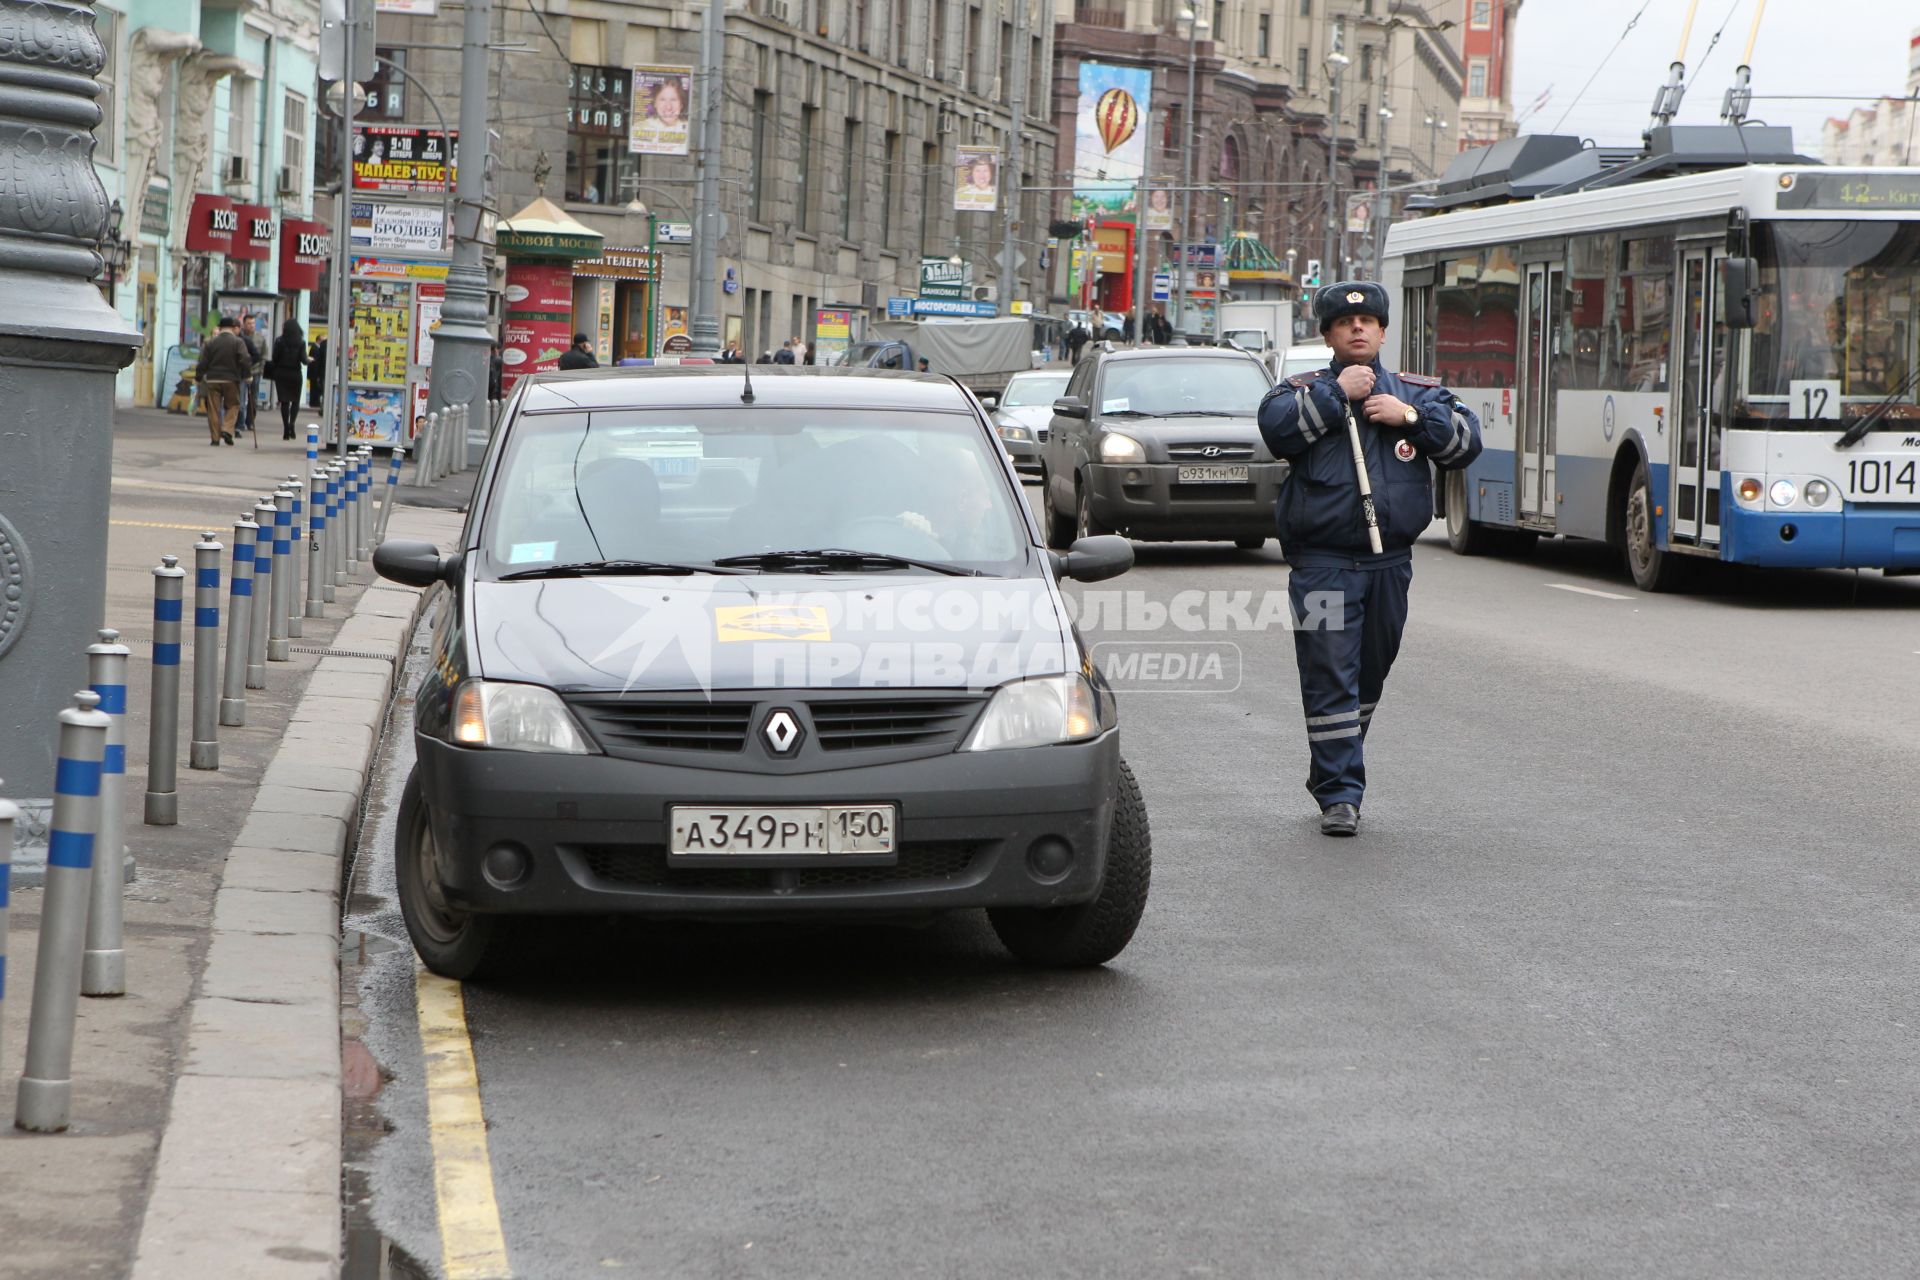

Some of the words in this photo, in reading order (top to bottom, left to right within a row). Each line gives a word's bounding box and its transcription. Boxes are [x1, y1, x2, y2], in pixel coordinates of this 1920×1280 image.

[353, 162, 411, 179] ЧАПАЕВ
[375, 204, 387, 214] 17
[386, 209, 411, 218] ноября
[374, 223, 441, 238] БРОДВЕЯ
[921, 287, 960, 297] БАНКОМАТ
[914, 300, 977, 314] МОСГОРСПРАВКА
[1803, 388, 1828, 419] 12
[1482, 401, 1495, 430] 1014
[1848, 460, 1916, 494] 1014
